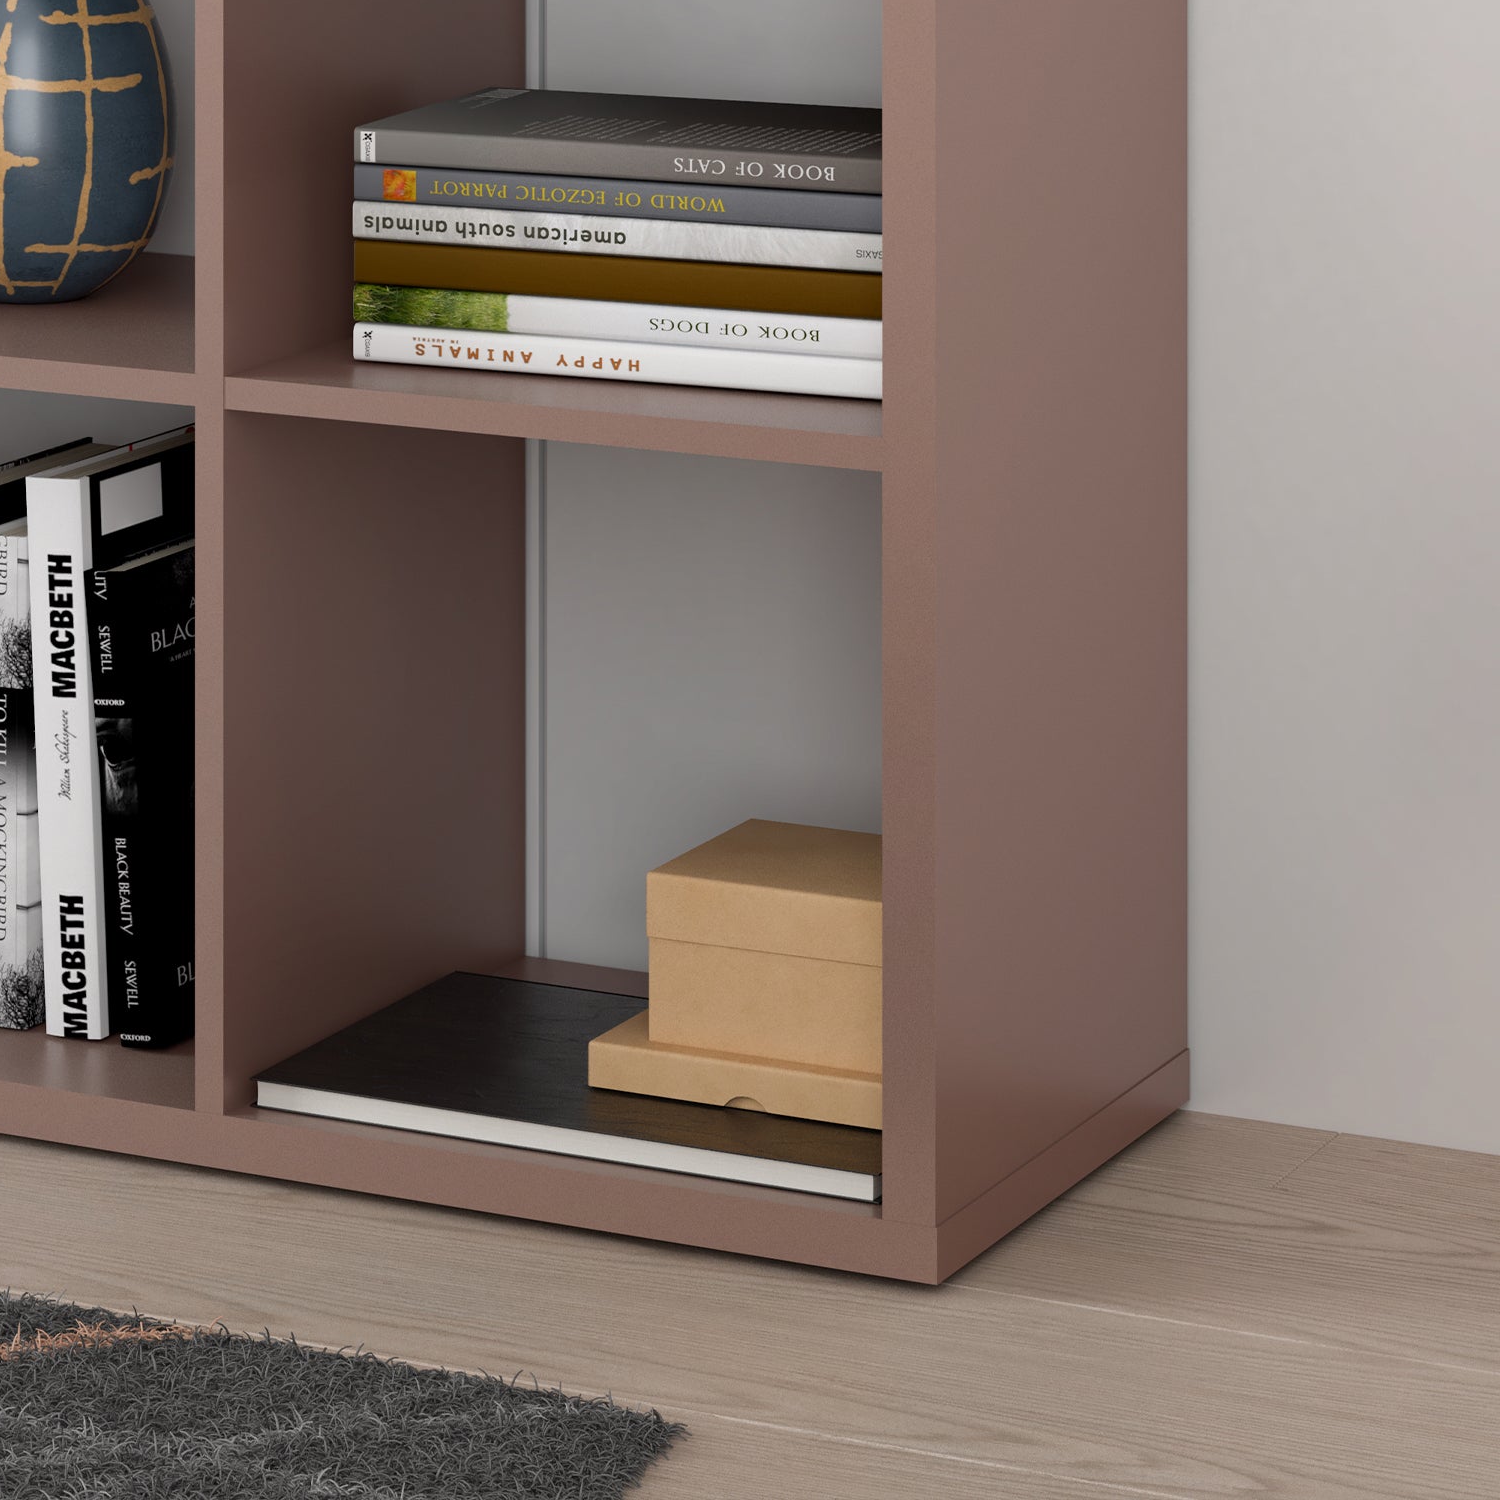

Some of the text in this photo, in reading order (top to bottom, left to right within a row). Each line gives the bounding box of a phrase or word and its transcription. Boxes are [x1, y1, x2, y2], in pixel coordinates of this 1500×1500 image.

[674, 157, 835, 182] BOOK OF CATS
[430, 180, 726, 212] WORLD OF EGZOTIC PARROT
[364, 215, 627, 246] american south animals
[649, 318, 820, 342] BOOK OF DOGS
[415, 343, 640, 372] HAPPY ANIMALS
[47, 553, 77, 698] MACBETH
[98, 625, 113, 674] SEWELL
[114, 837, 134, 936] BLACK BEAUTY
[59, 894, 88, 1040] MACBETH
[124, 960, 139, 1009] SEWELL
[120, 1033, 151, 1042] OXFORD
